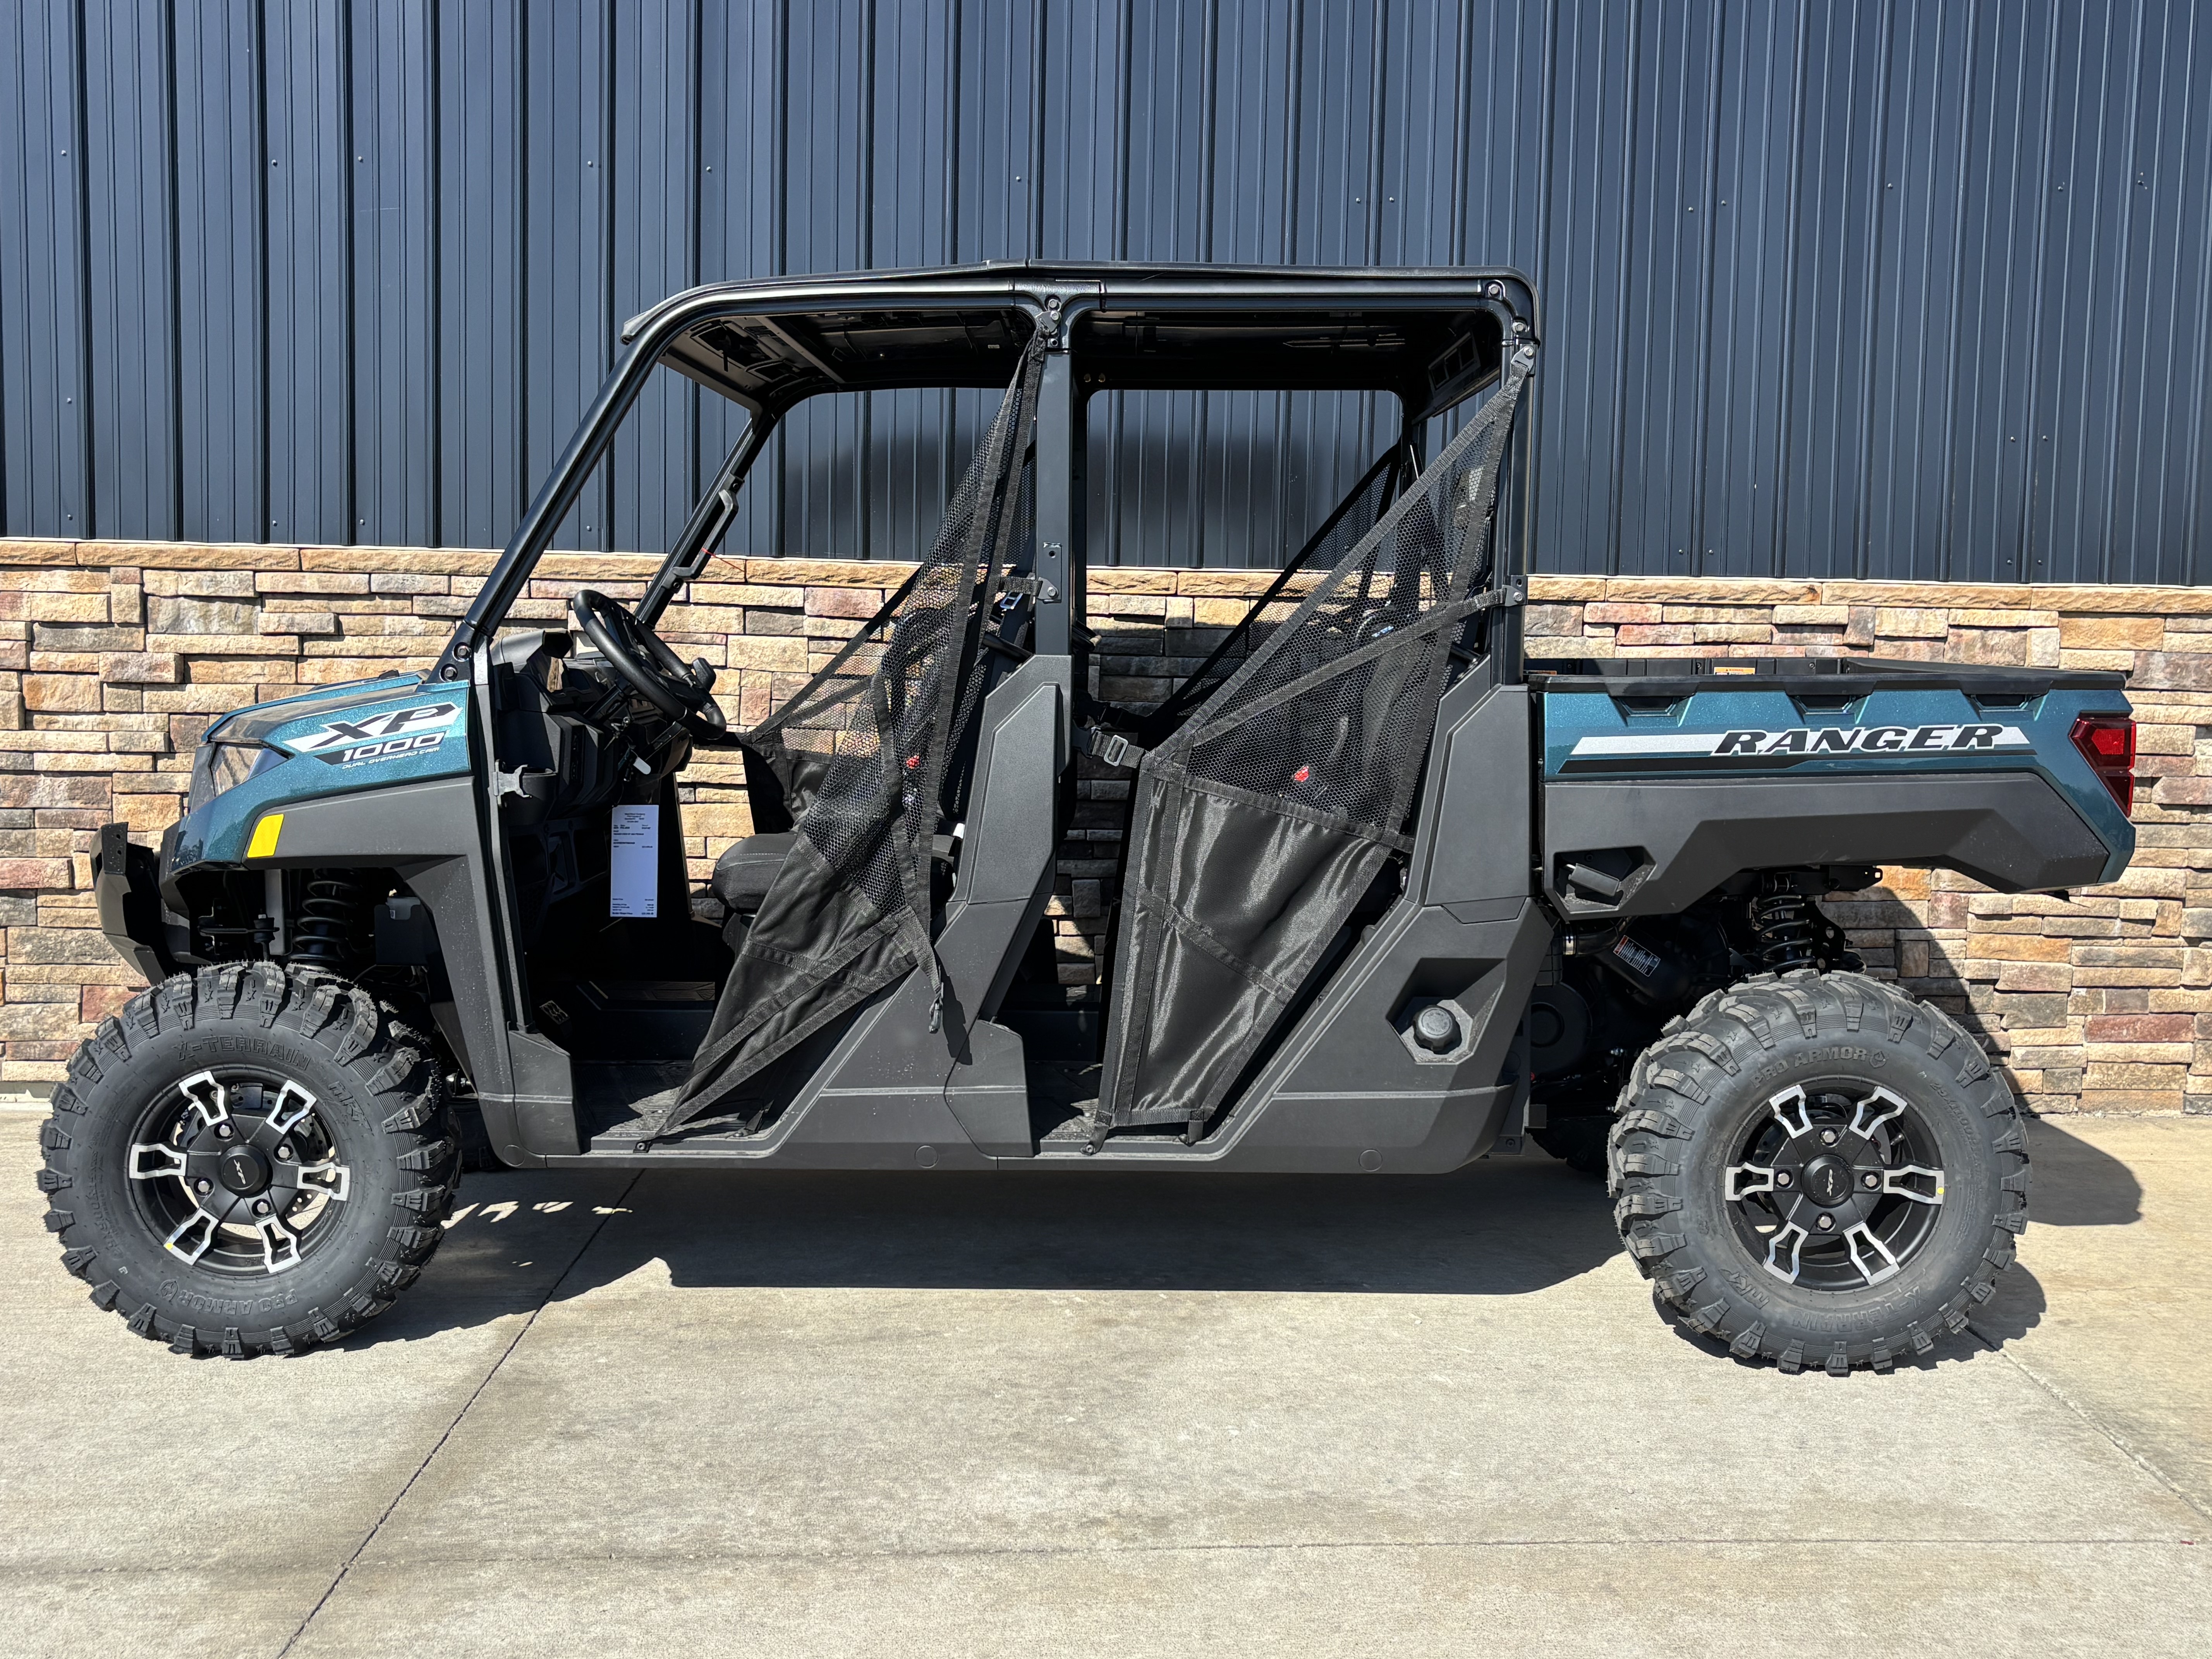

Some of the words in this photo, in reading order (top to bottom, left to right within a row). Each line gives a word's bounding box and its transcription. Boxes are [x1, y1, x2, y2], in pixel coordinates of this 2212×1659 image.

[309, 704, 455, 749] XP
[1712, 724, 2003, 755] RANGER
[343, 732, 445, 762] 1000
[369, 751, 417, 764] OVERHEAD
[172, 1035, 311, 1071] X-TERRAIN
[1750, 1060, 1789, 1088] PRO
[1795, 1046, 1867, 1067] ARMOR
[178, 1290, 253, 1315] ARMOR
[259, 1288, 298, 1312] PRO
[1793, 1286, 1925, 1332] X-TERRAIN
